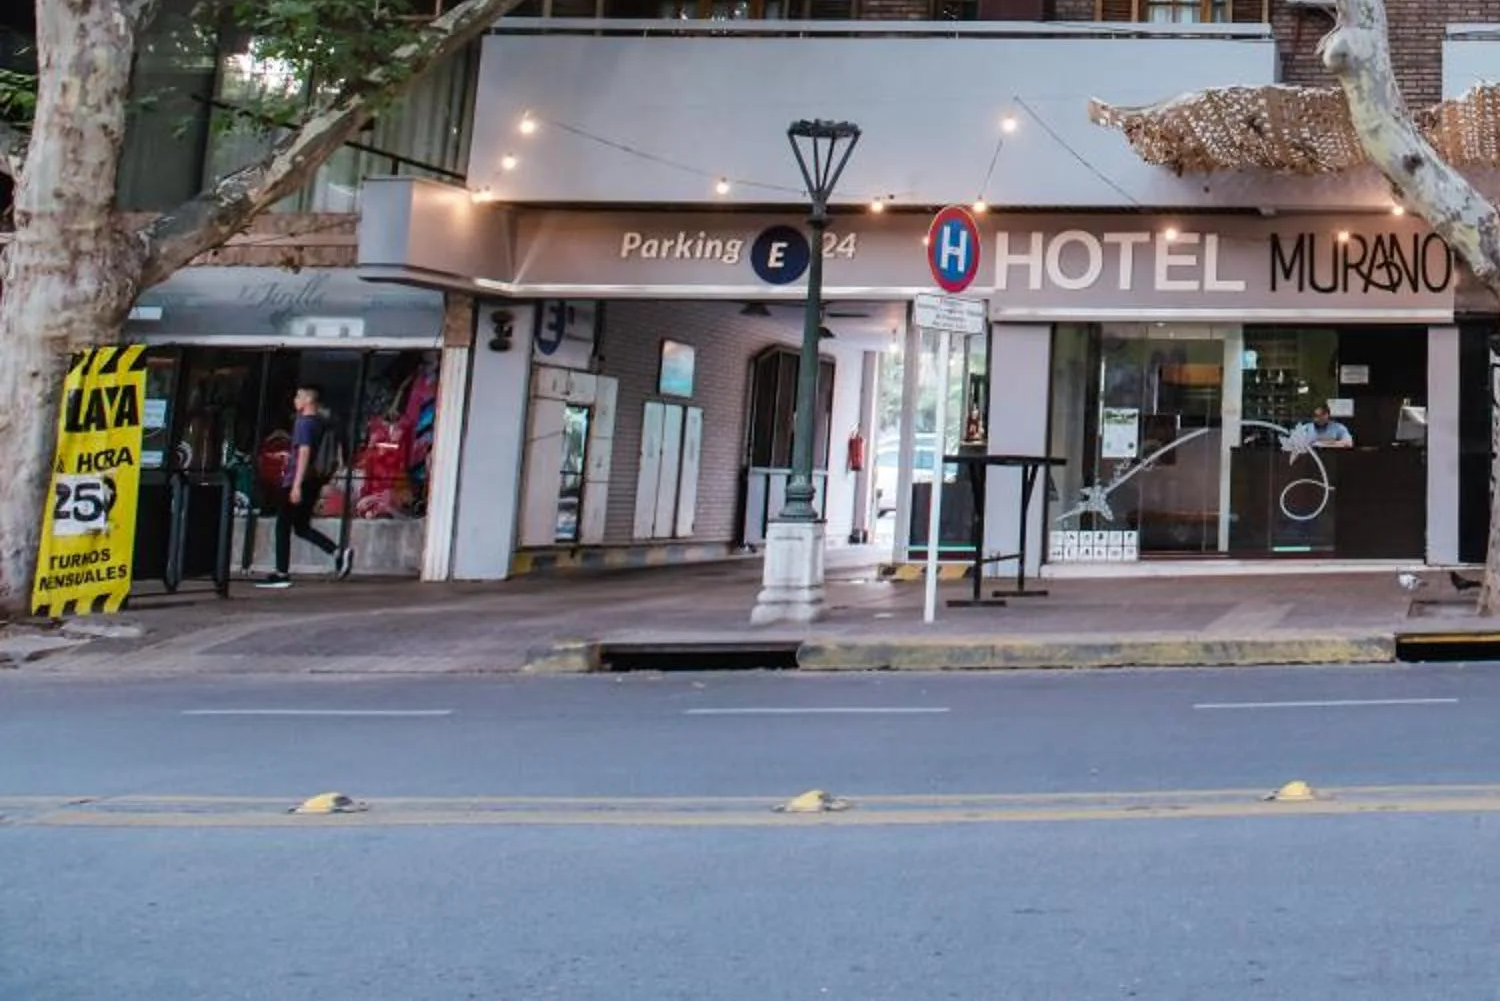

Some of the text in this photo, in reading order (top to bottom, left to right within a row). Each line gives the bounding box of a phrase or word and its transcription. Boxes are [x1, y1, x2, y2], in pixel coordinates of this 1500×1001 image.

[620, 231, 857, 269] Parking E 24
[940, 216, 968, 272] H
[995, 229, 1451, 294] HOTEL MURANO
